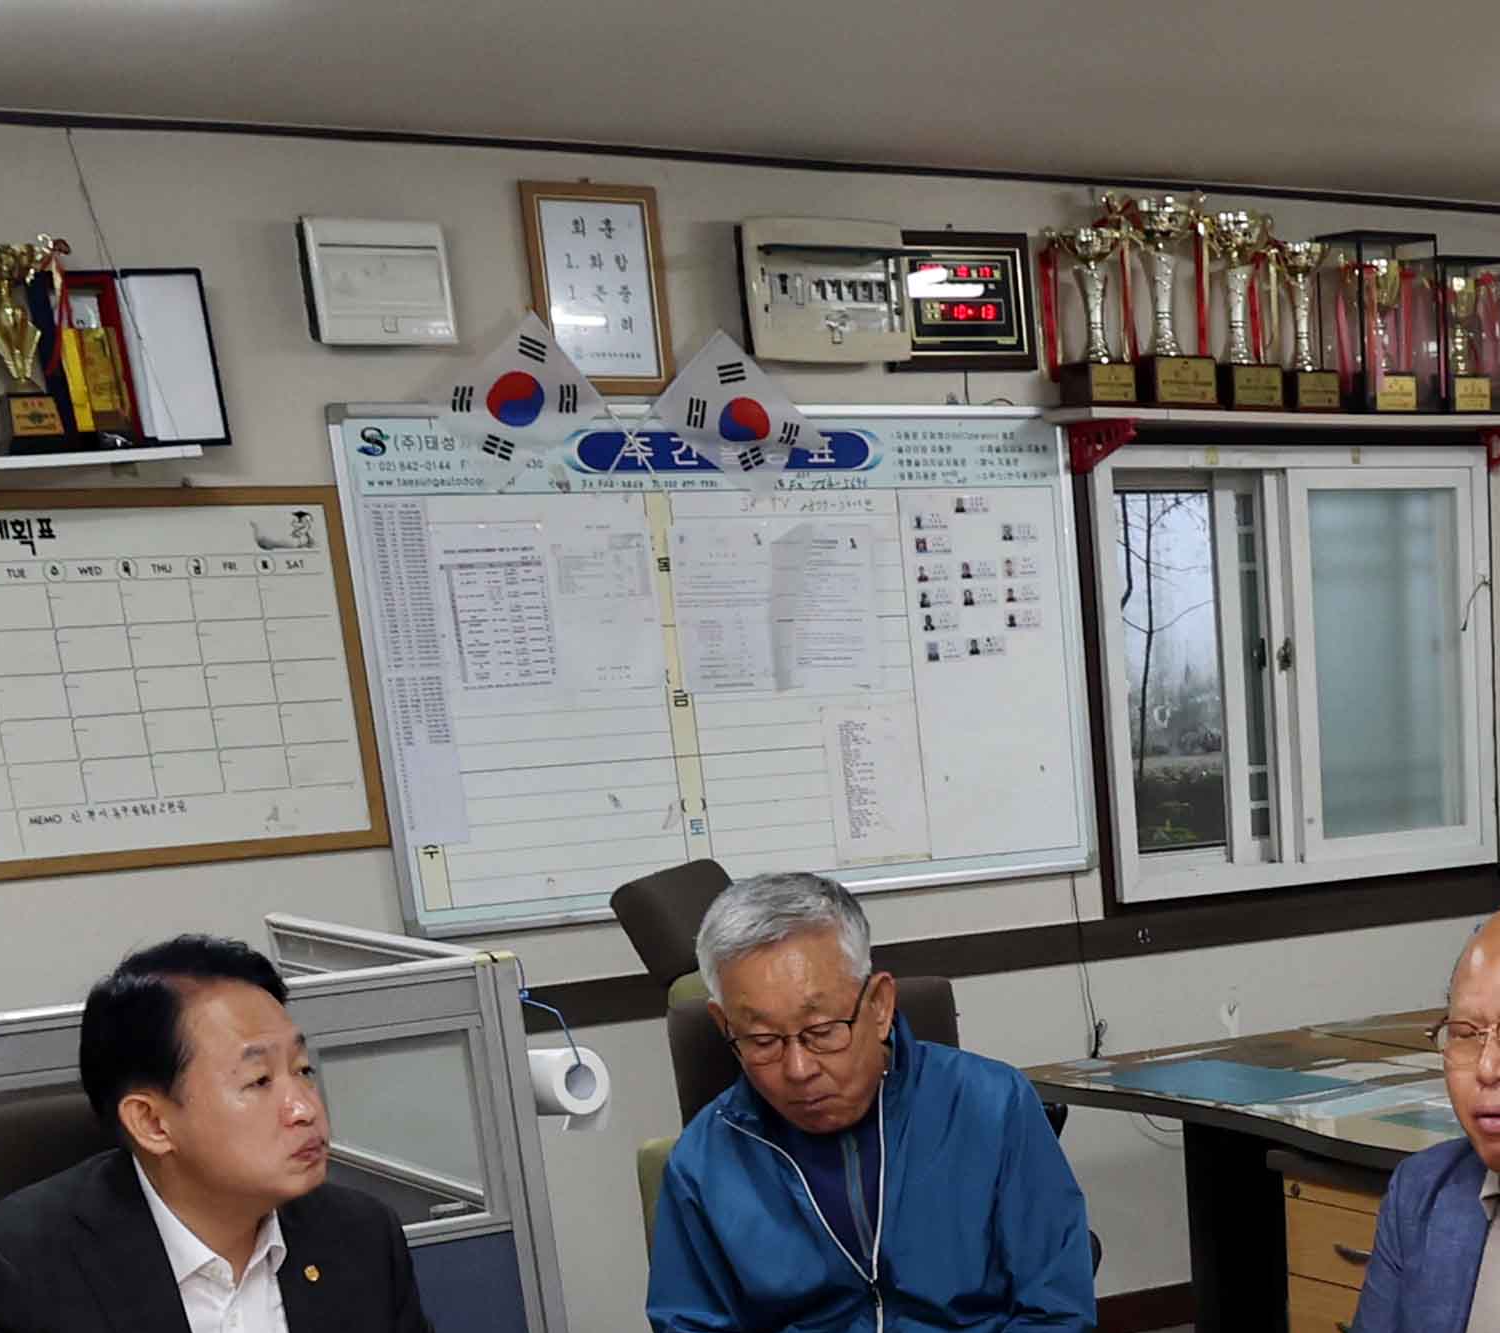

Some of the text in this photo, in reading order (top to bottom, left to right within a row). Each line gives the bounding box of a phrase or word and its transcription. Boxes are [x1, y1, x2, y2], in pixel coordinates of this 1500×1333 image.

[6, 567, 27, 579] TUE
[77, 565, 102, 577] WED
[151, 564, 172, 575] THU
[222, 561, 238, 572] FRI
[285, 560, 305, 571] SAT
[29, 814, 62, 825] MEMO
